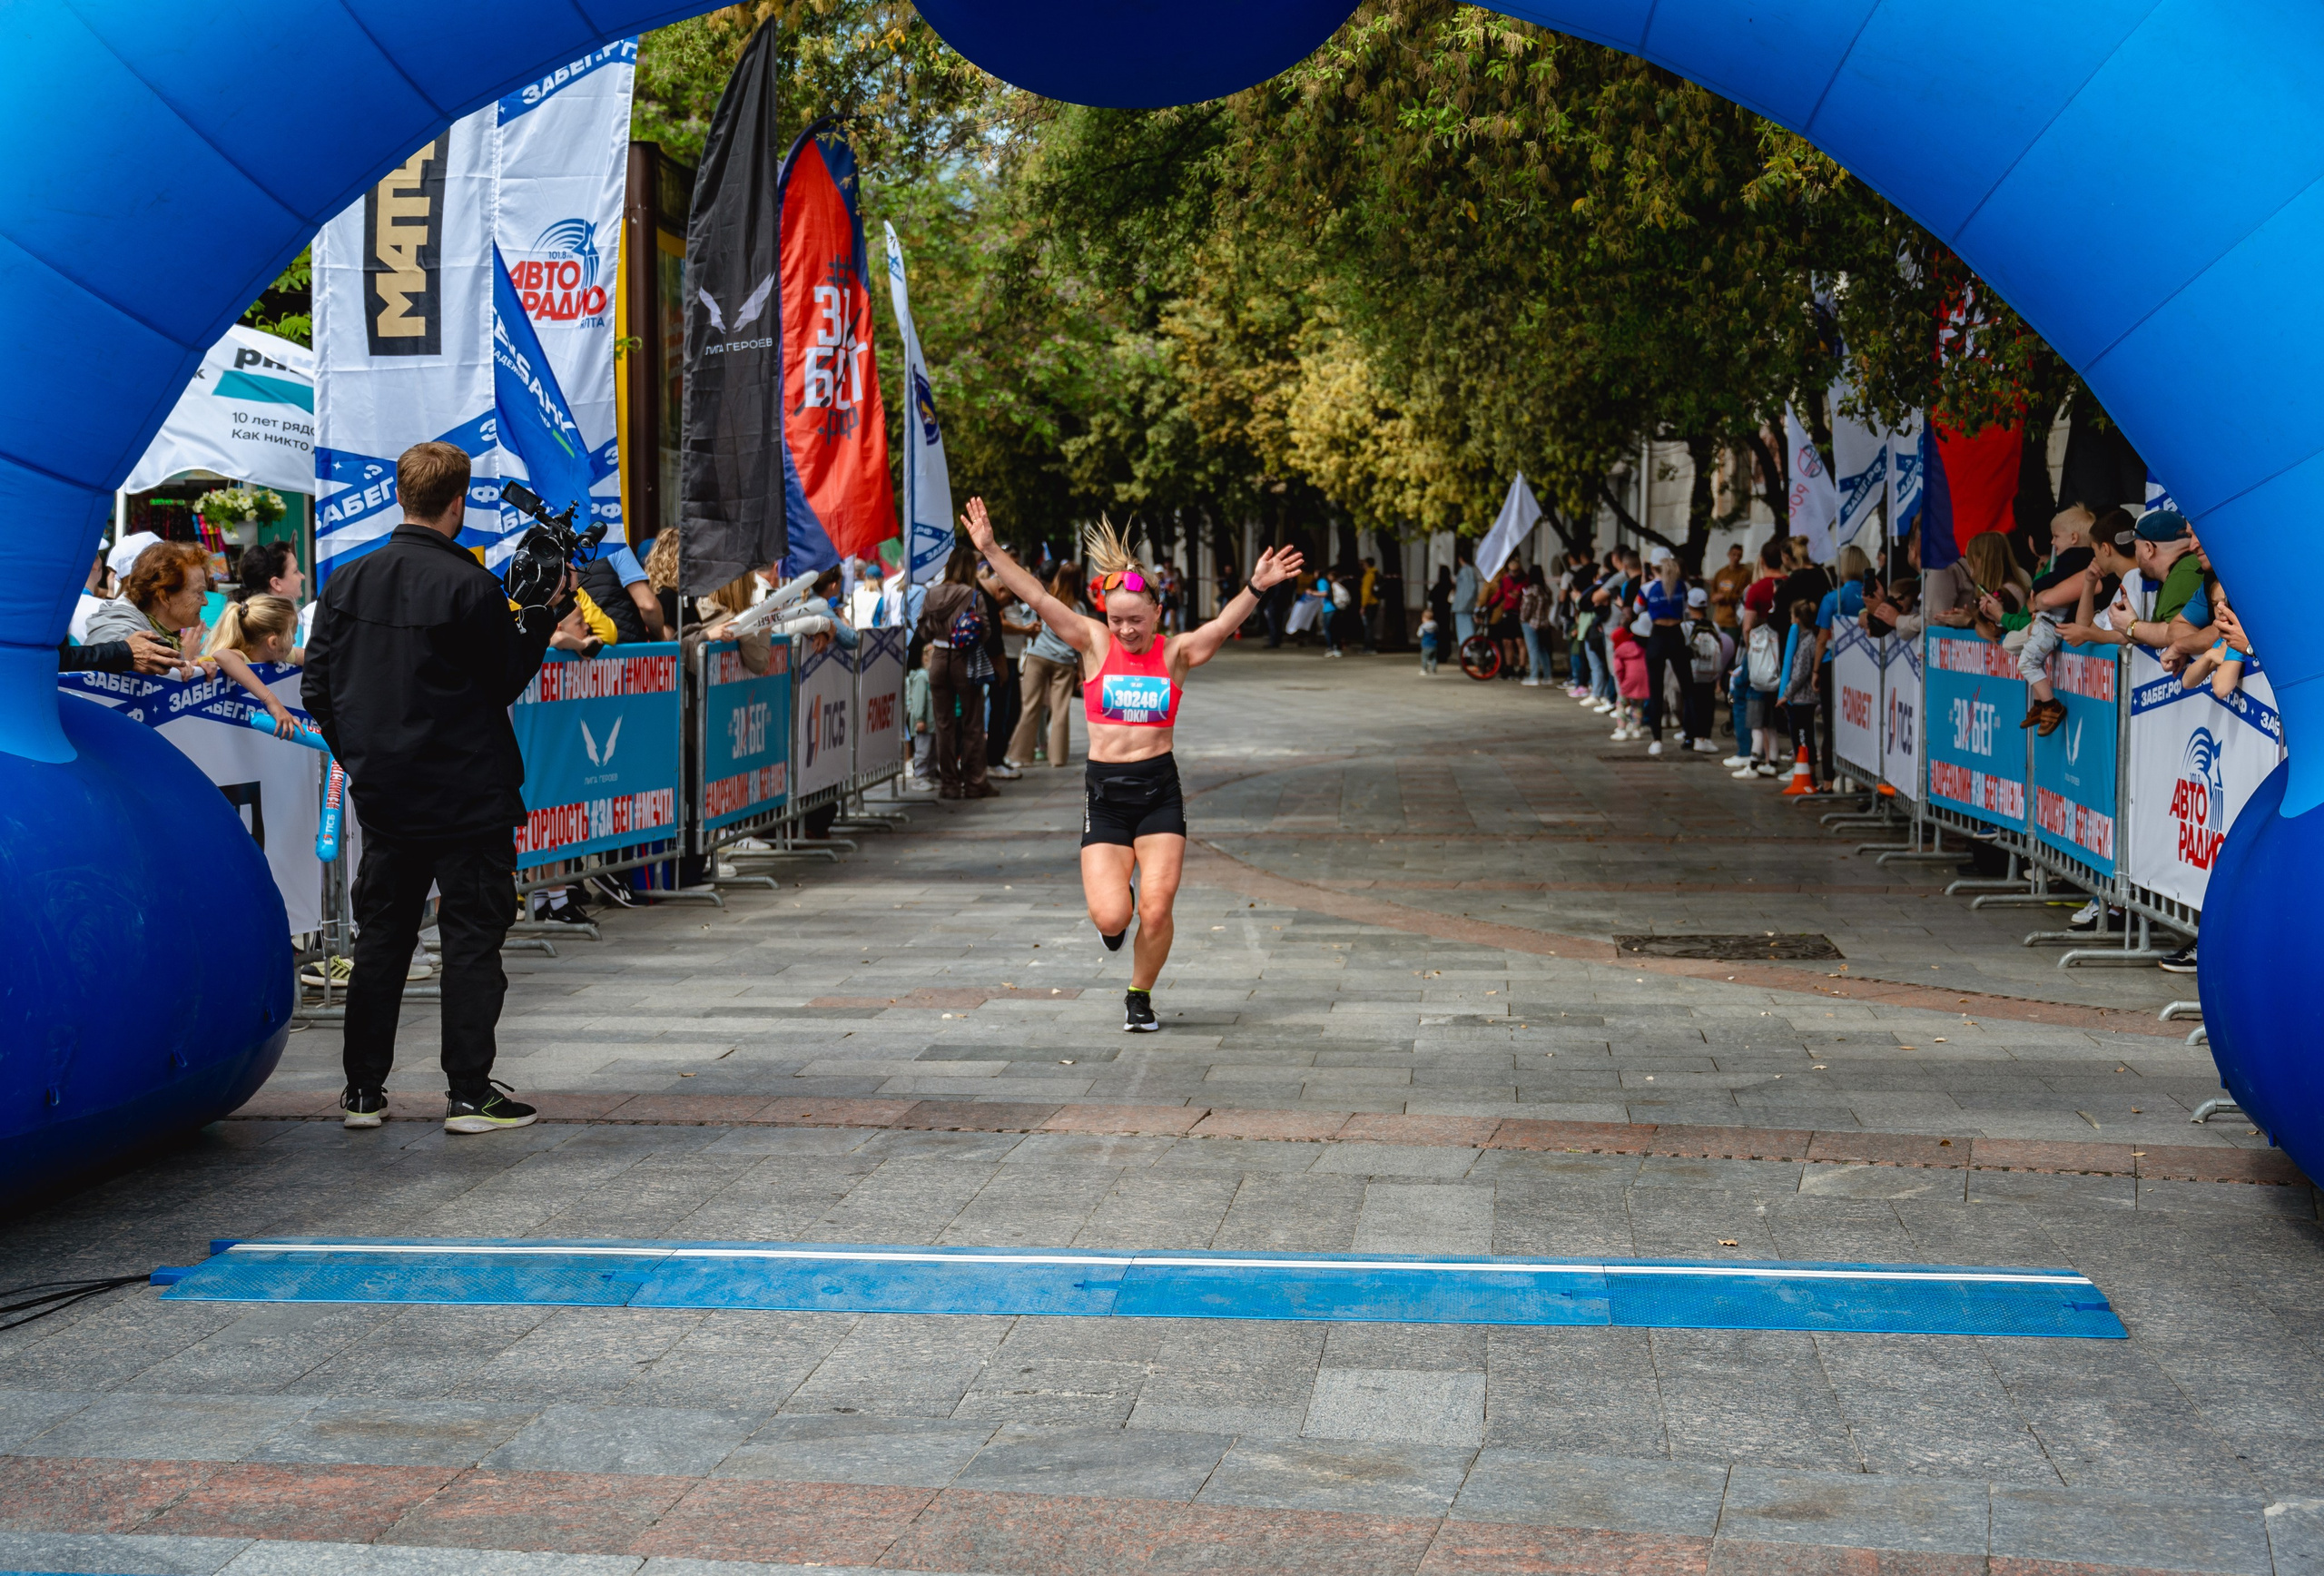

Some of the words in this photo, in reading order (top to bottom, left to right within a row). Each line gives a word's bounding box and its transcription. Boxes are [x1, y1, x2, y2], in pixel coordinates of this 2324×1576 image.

[509, 260, 581, 291] АВТО
[522, 284, 607, 321] РАДИО
[580, 317, 605, 330] ЯЛТА
[704, 343, 724, 355] ЛИГА
[726, 338, 773, 352] ГЕРОЕВ
[231, 412, 248, 424] 10
[251, 416, 279, 428] лет
[231, 428, 260, 440] Как
[264, 433, 309, 451] никто
[565, 658, 625, 700] #ВОСТОРГ
[625, 655, 677, 695] #МОМЕНТ
[2141, 678, 2182, 707] ЗАБЕГ.РФ
[1114, 690, 1157, 709] 30246
[1842, 685, 1873, 731] FONBET
[823, 700, 846, 752] ПСБ
[1123, 709, 1148, 724] 10KM
[1897, 701, 1913, 755] ПСБ
[326, 759, 344, 810] #ЕДИНСТВ
[591, 794, 633, 839] #ЗАБЕГ
[635, 787, 675, 830] #МЕЧТА
[2169, 778, 2208, 826] АВТО
[325, 813, 336, 832] ПСБ
